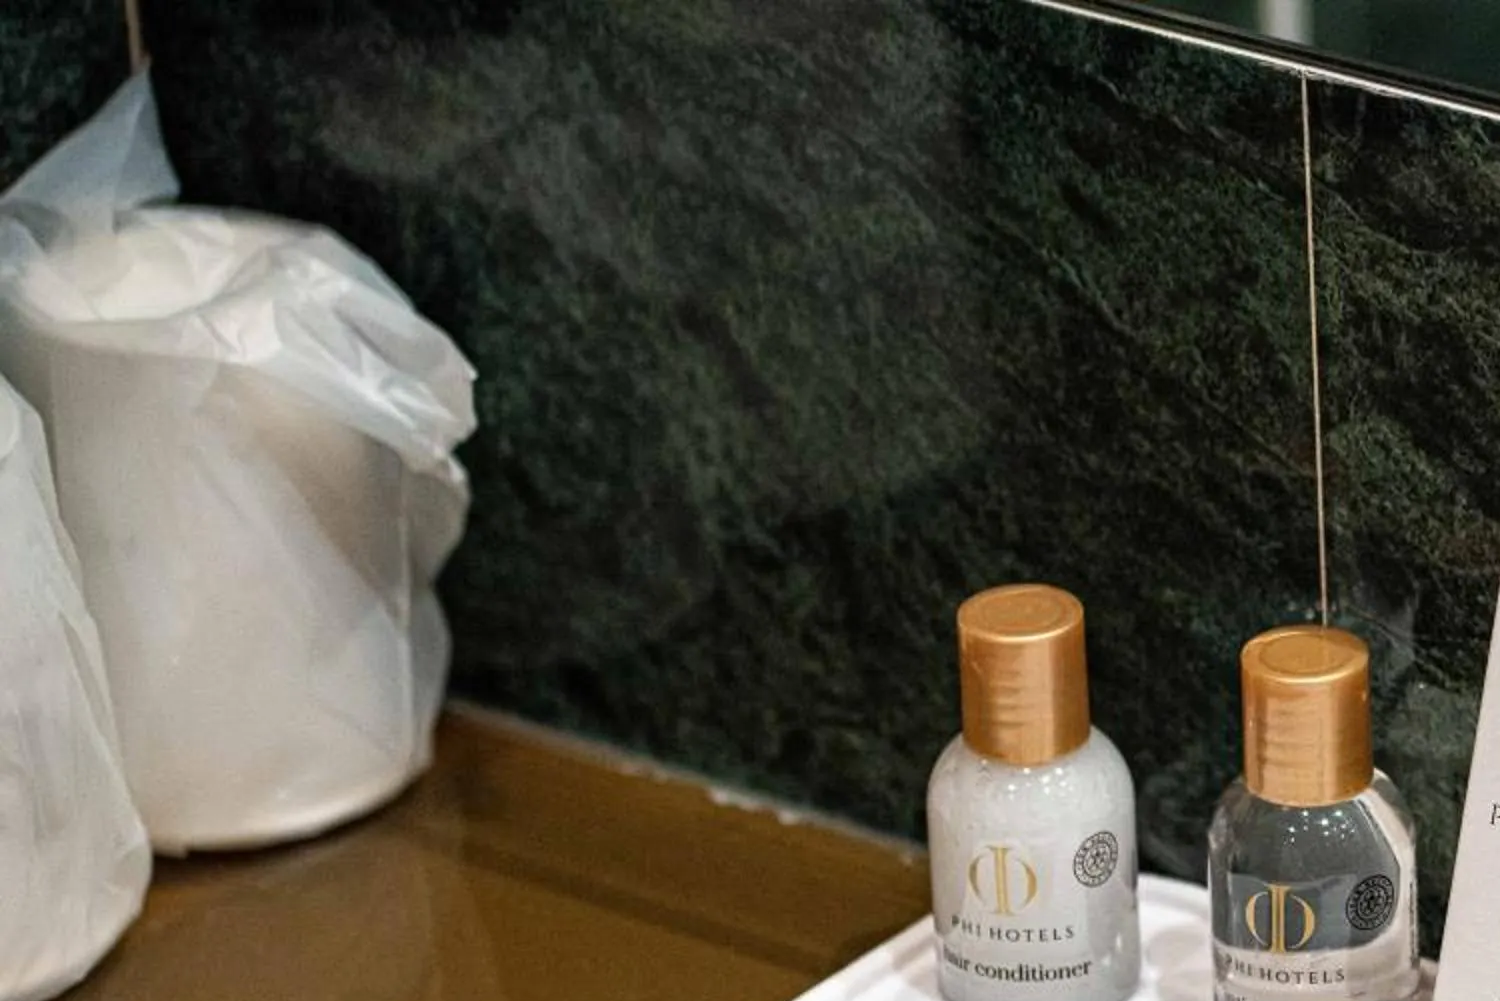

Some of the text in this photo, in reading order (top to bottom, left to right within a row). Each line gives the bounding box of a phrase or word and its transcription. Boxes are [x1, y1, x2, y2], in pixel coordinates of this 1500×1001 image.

[951, 914, 1077, 943] PHI HOTELS
[974, 958, 1093, 983] conditioner
[1258, 967, 1346, 985] HOTELS
